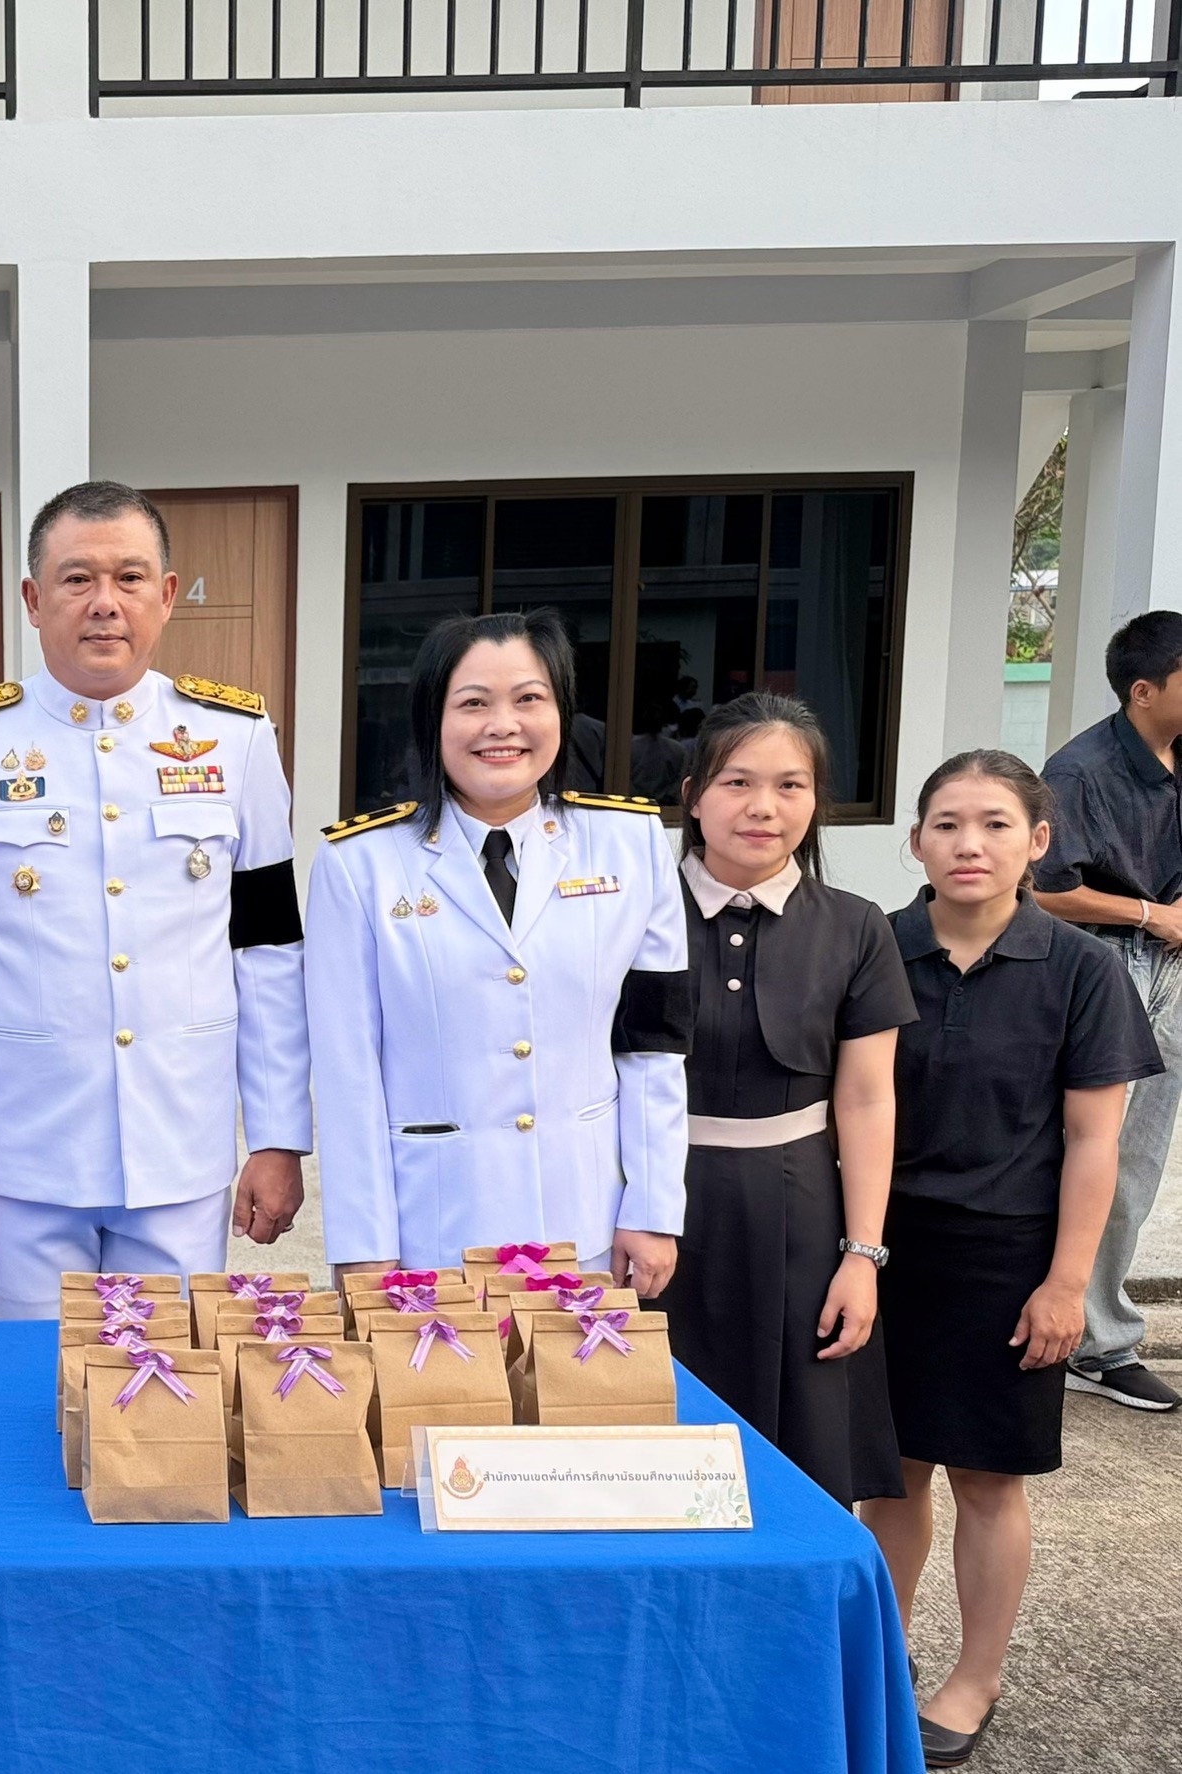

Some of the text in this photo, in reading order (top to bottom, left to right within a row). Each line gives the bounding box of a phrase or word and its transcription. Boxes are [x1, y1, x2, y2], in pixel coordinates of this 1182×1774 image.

[186, 576, 207, 605] 4
[483, 1468, 736, 1482] สำนักงานเขตพื้นที่การศึกษามัธยมศึกษาแม่ฮ่องสอน
